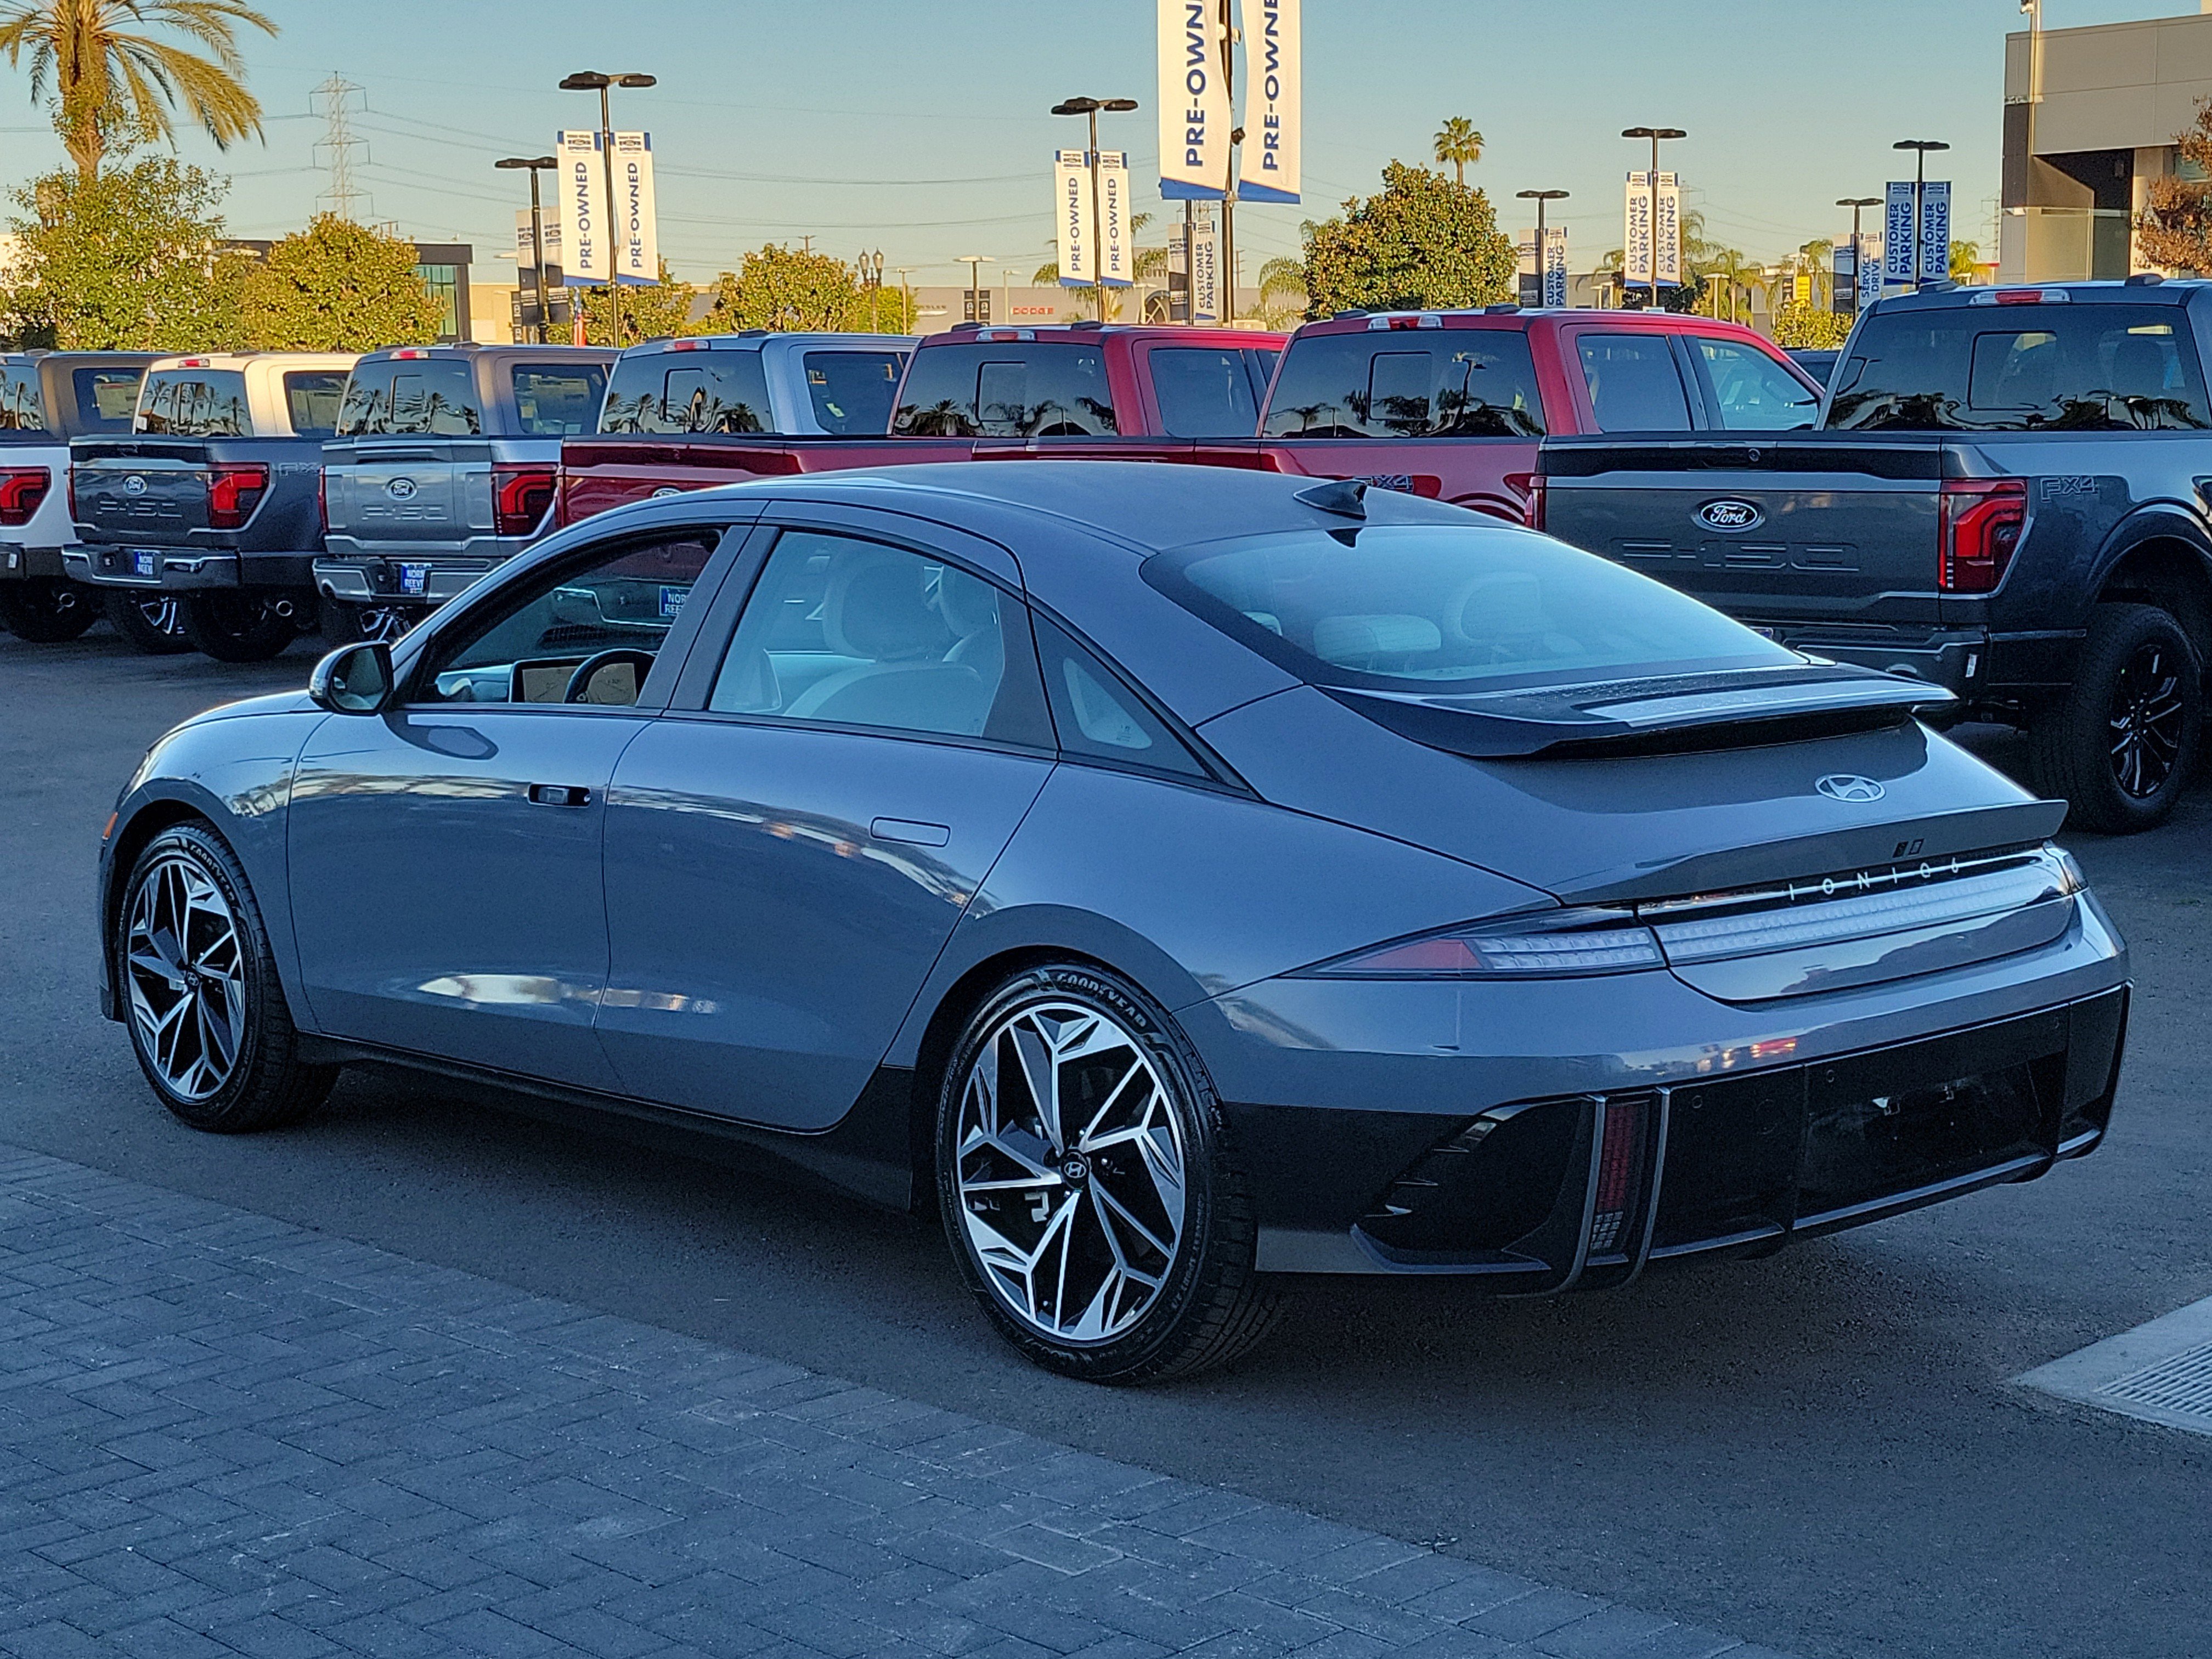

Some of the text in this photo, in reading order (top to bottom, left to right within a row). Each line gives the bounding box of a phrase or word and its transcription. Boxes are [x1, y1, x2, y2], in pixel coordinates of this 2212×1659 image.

[1186, 0, 1206, 167] PRE-OWN
[575, 161, 592, 269] PRE-OWNED
[628, 162, 642, 268] PRE-OWNED
[1068, 177, 1081, 272] PRE-OWNED
[1108, 178, 1120, 272] PRE-OWNED
[1629, 196, 1638, 272] CUSTOMER
[1638, 195, 1648, 273] PARKING
[1666, 195, 1675, 273] PARKING
[1888, 203, 1899, 273] CUSTOMER
[1900, 202, 1912, 274] PARKING
[1925, 203, 1935, 272] CUSTOMER
[1935, 201, 1946, 274] PARKING
[1197, 243, 1206, 308] CUSTOMER
[1205, 241, 1214, 309] PARKING
[1556, 245, 1564, 306] PARKING
[1861, 252, 1870, 298] SERVICE
[1871, 257, 1880, 292] DRIVE
[279, 462, 323, 477] FX
[2040, 477, 2099, 503] FX4
[1710, 505, 1747, 523] Ford
[665, 603, 683, 614] REE
[668, 593, 686, 603] NOR
[1788, 856, 1959, 901] IONIQ 6
[1057, 973, 1147, 1028] GOODYEAR
